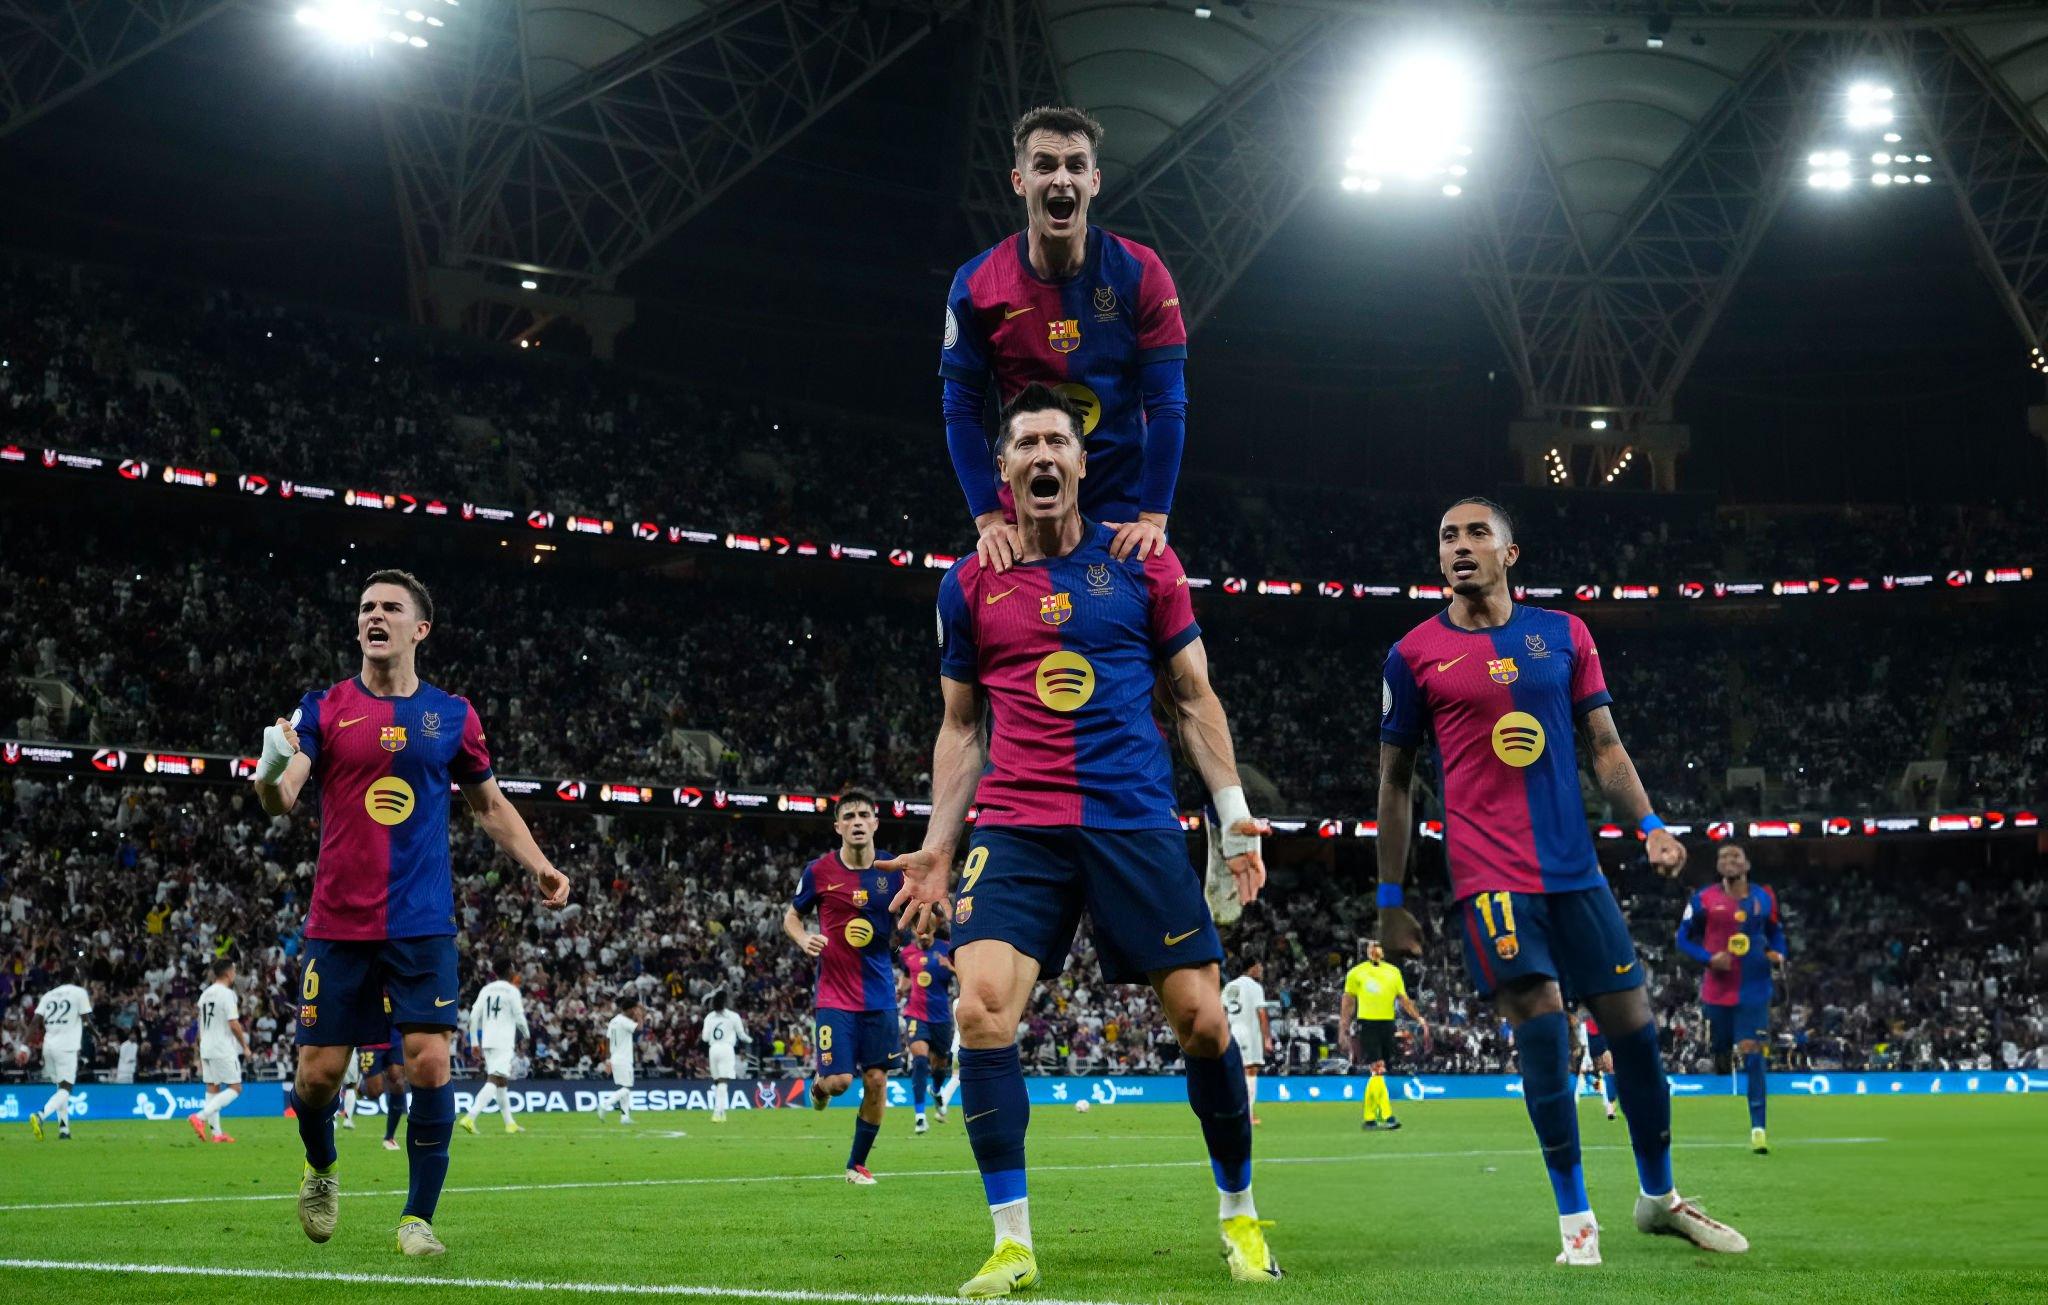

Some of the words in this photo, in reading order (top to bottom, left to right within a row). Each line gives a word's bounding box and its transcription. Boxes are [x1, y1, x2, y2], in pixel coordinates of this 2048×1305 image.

[961, 846, 989, 893] 9
[1476, 891, 1516, 937] 11
[303, 959, 319, 1000] 6
[45, 1000, 71, 1024] 22
[203, 1002, 215, 1029] 17
[487, 995, 501, 1018] 14
[713, 1022, 723, 1040] 6
[819, 1025, 832, 1050] 8
